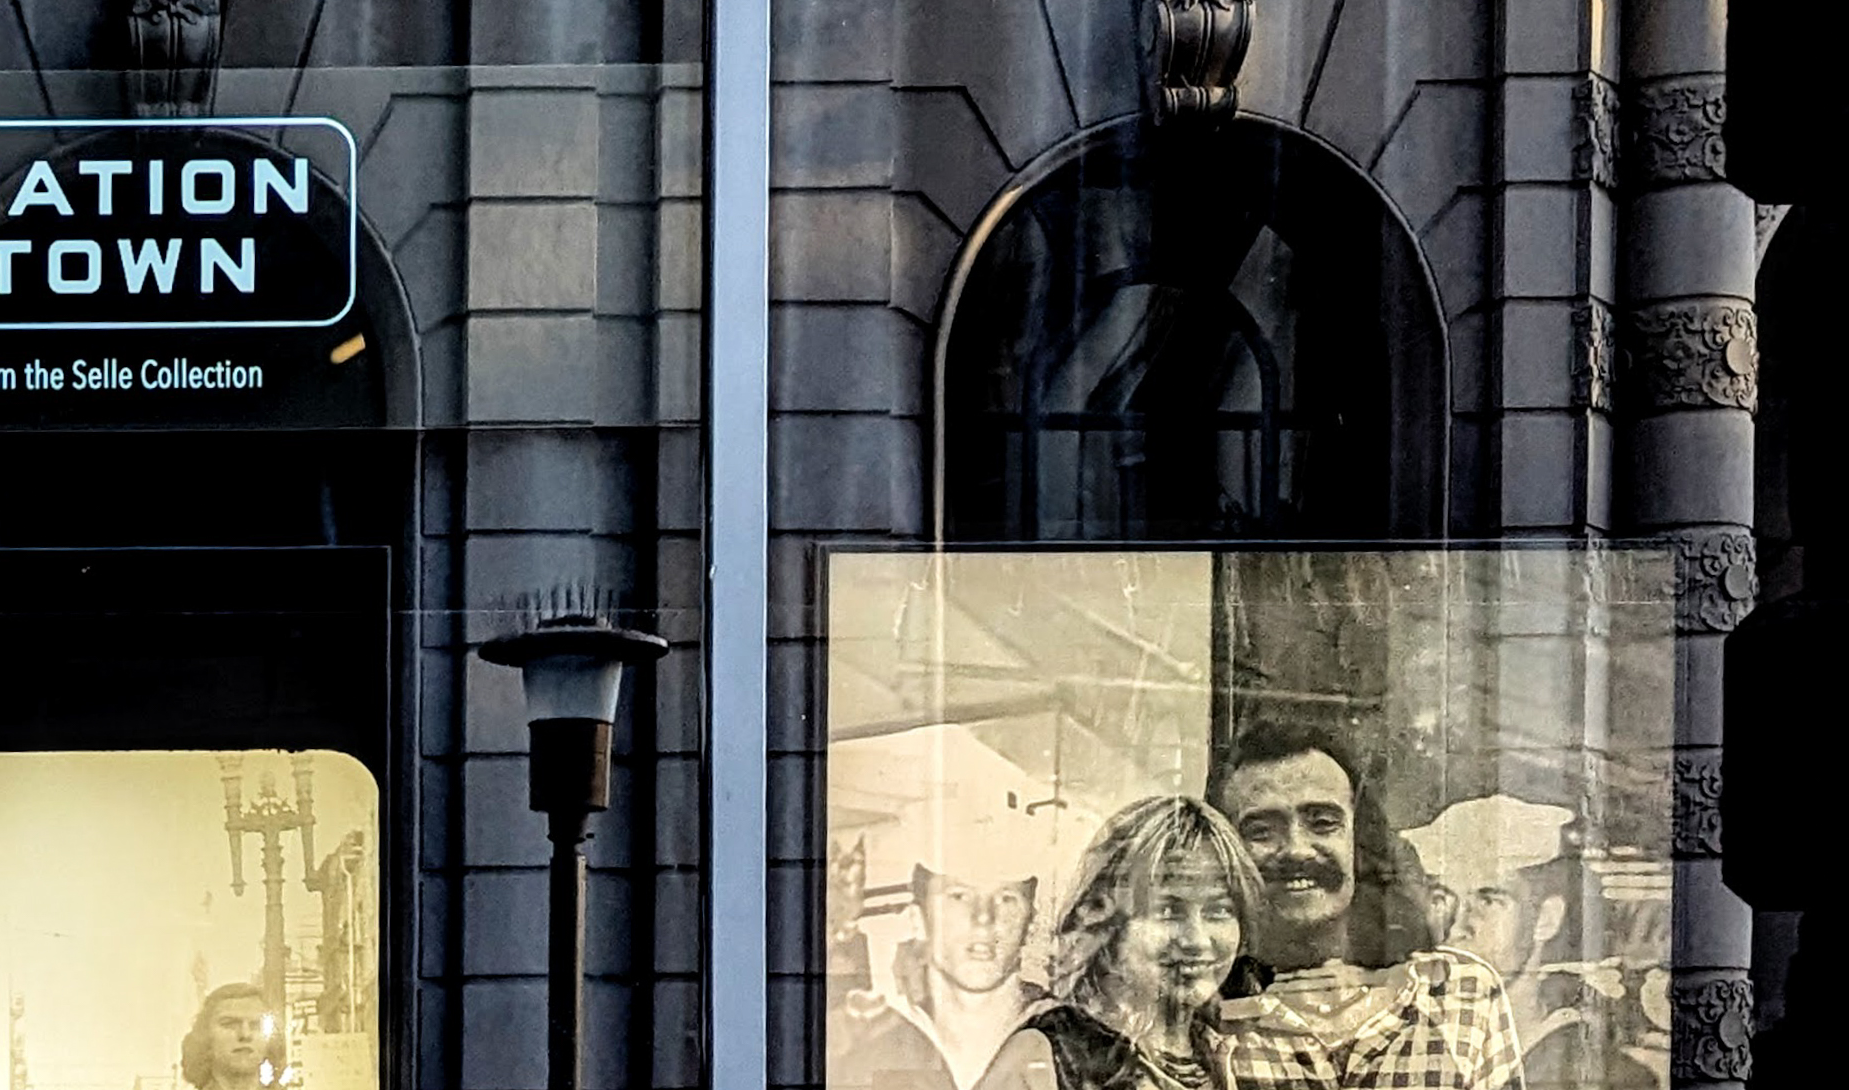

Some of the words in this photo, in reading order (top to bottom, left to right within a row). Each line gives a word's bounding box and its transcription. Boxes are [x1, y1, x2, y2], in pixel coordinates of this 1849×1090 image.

[24, 358, 65, 391] the
[71, 357, 134, 391] Selle
[140, 357, 264, 390] Collection
